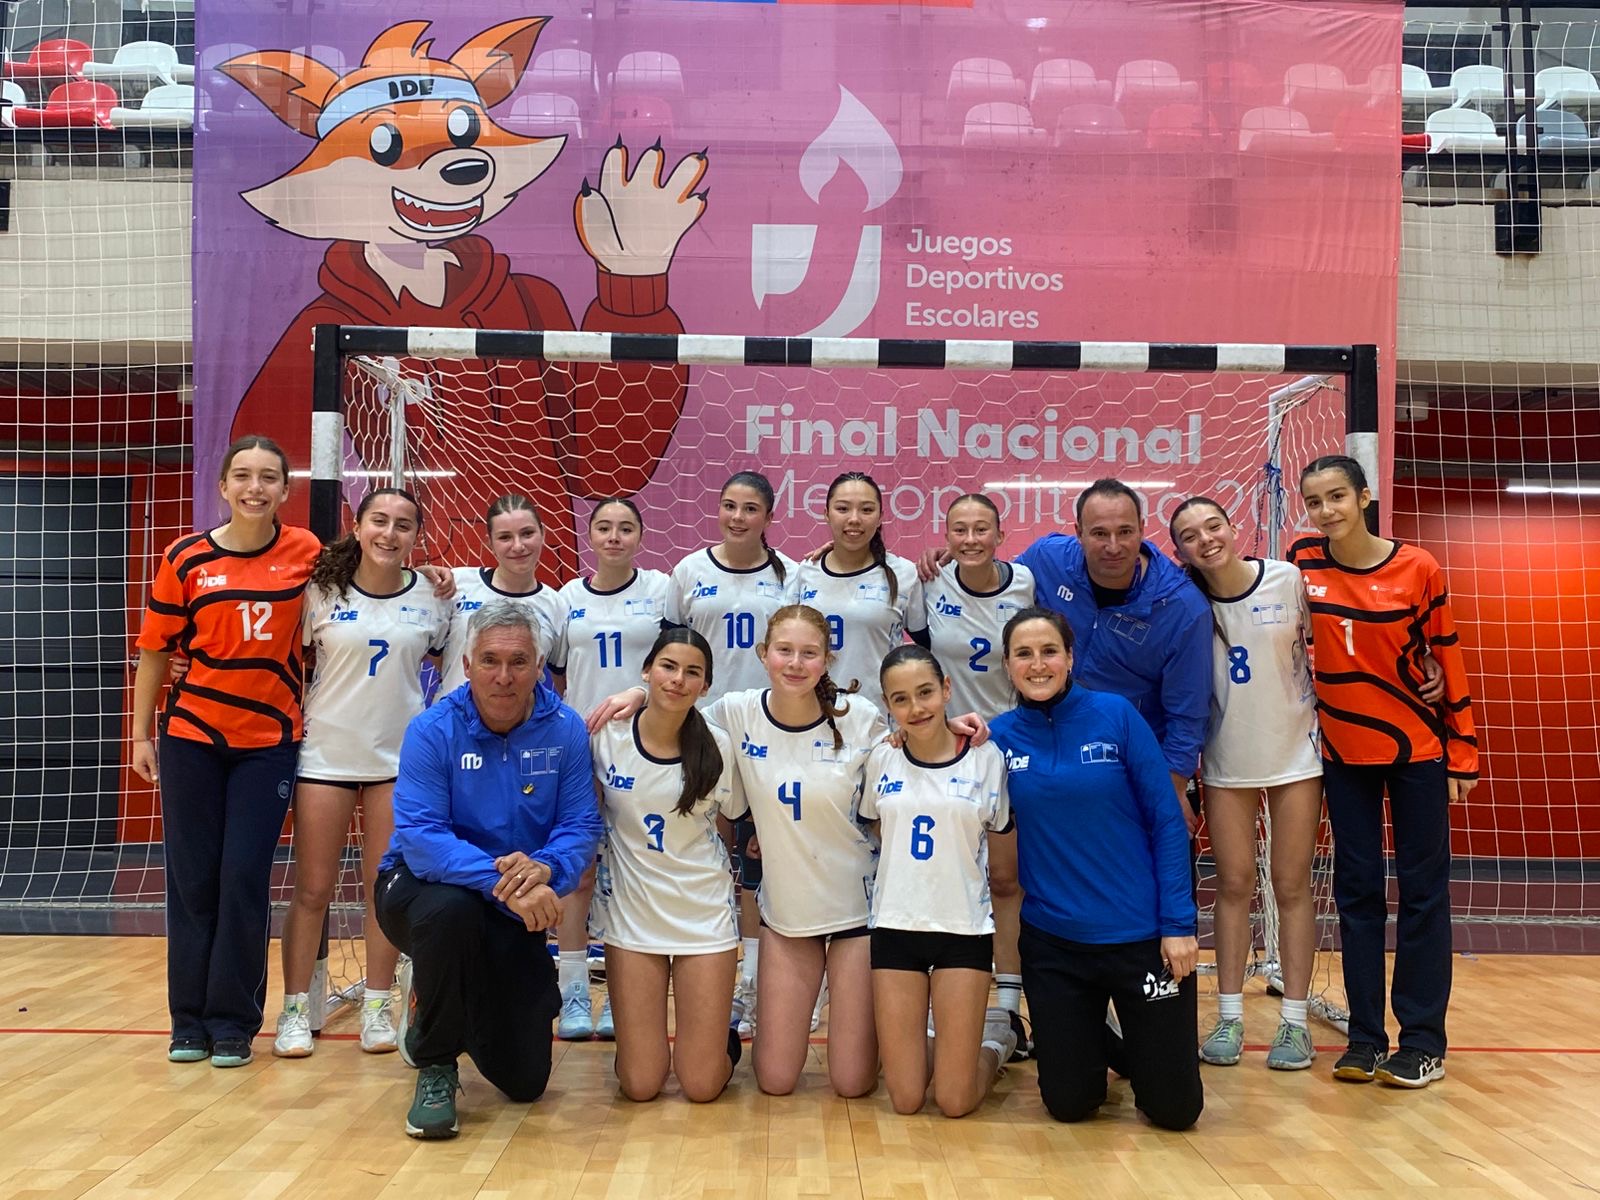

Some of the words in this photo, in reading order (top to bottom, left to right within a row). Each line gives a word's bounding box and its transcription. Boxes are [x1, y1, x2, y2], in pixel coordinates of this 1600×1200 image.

[906, 228, 1012, 261] Juegos
[906, 263, 1064, 295] Deportivos
[906, 302, 1040, 329] Escolares
[745, 402, 898, 456] Final
[917, 408, 1202, 465] Nacional
[235, 601, 272, 641] 12
[722, 612, 754, 649] 10
[1339, 619, 1355, 656] 1
[368, 639, 389, 676] 7
[593, 632, 622, 668] 11
[969, 637, 991, 672] 2
[1228, 646, 1251, 684] 8
[778, 782, 801, 821] 4
[643, 814, 665, 853] 3
[911, 815, 935, 860] 6
